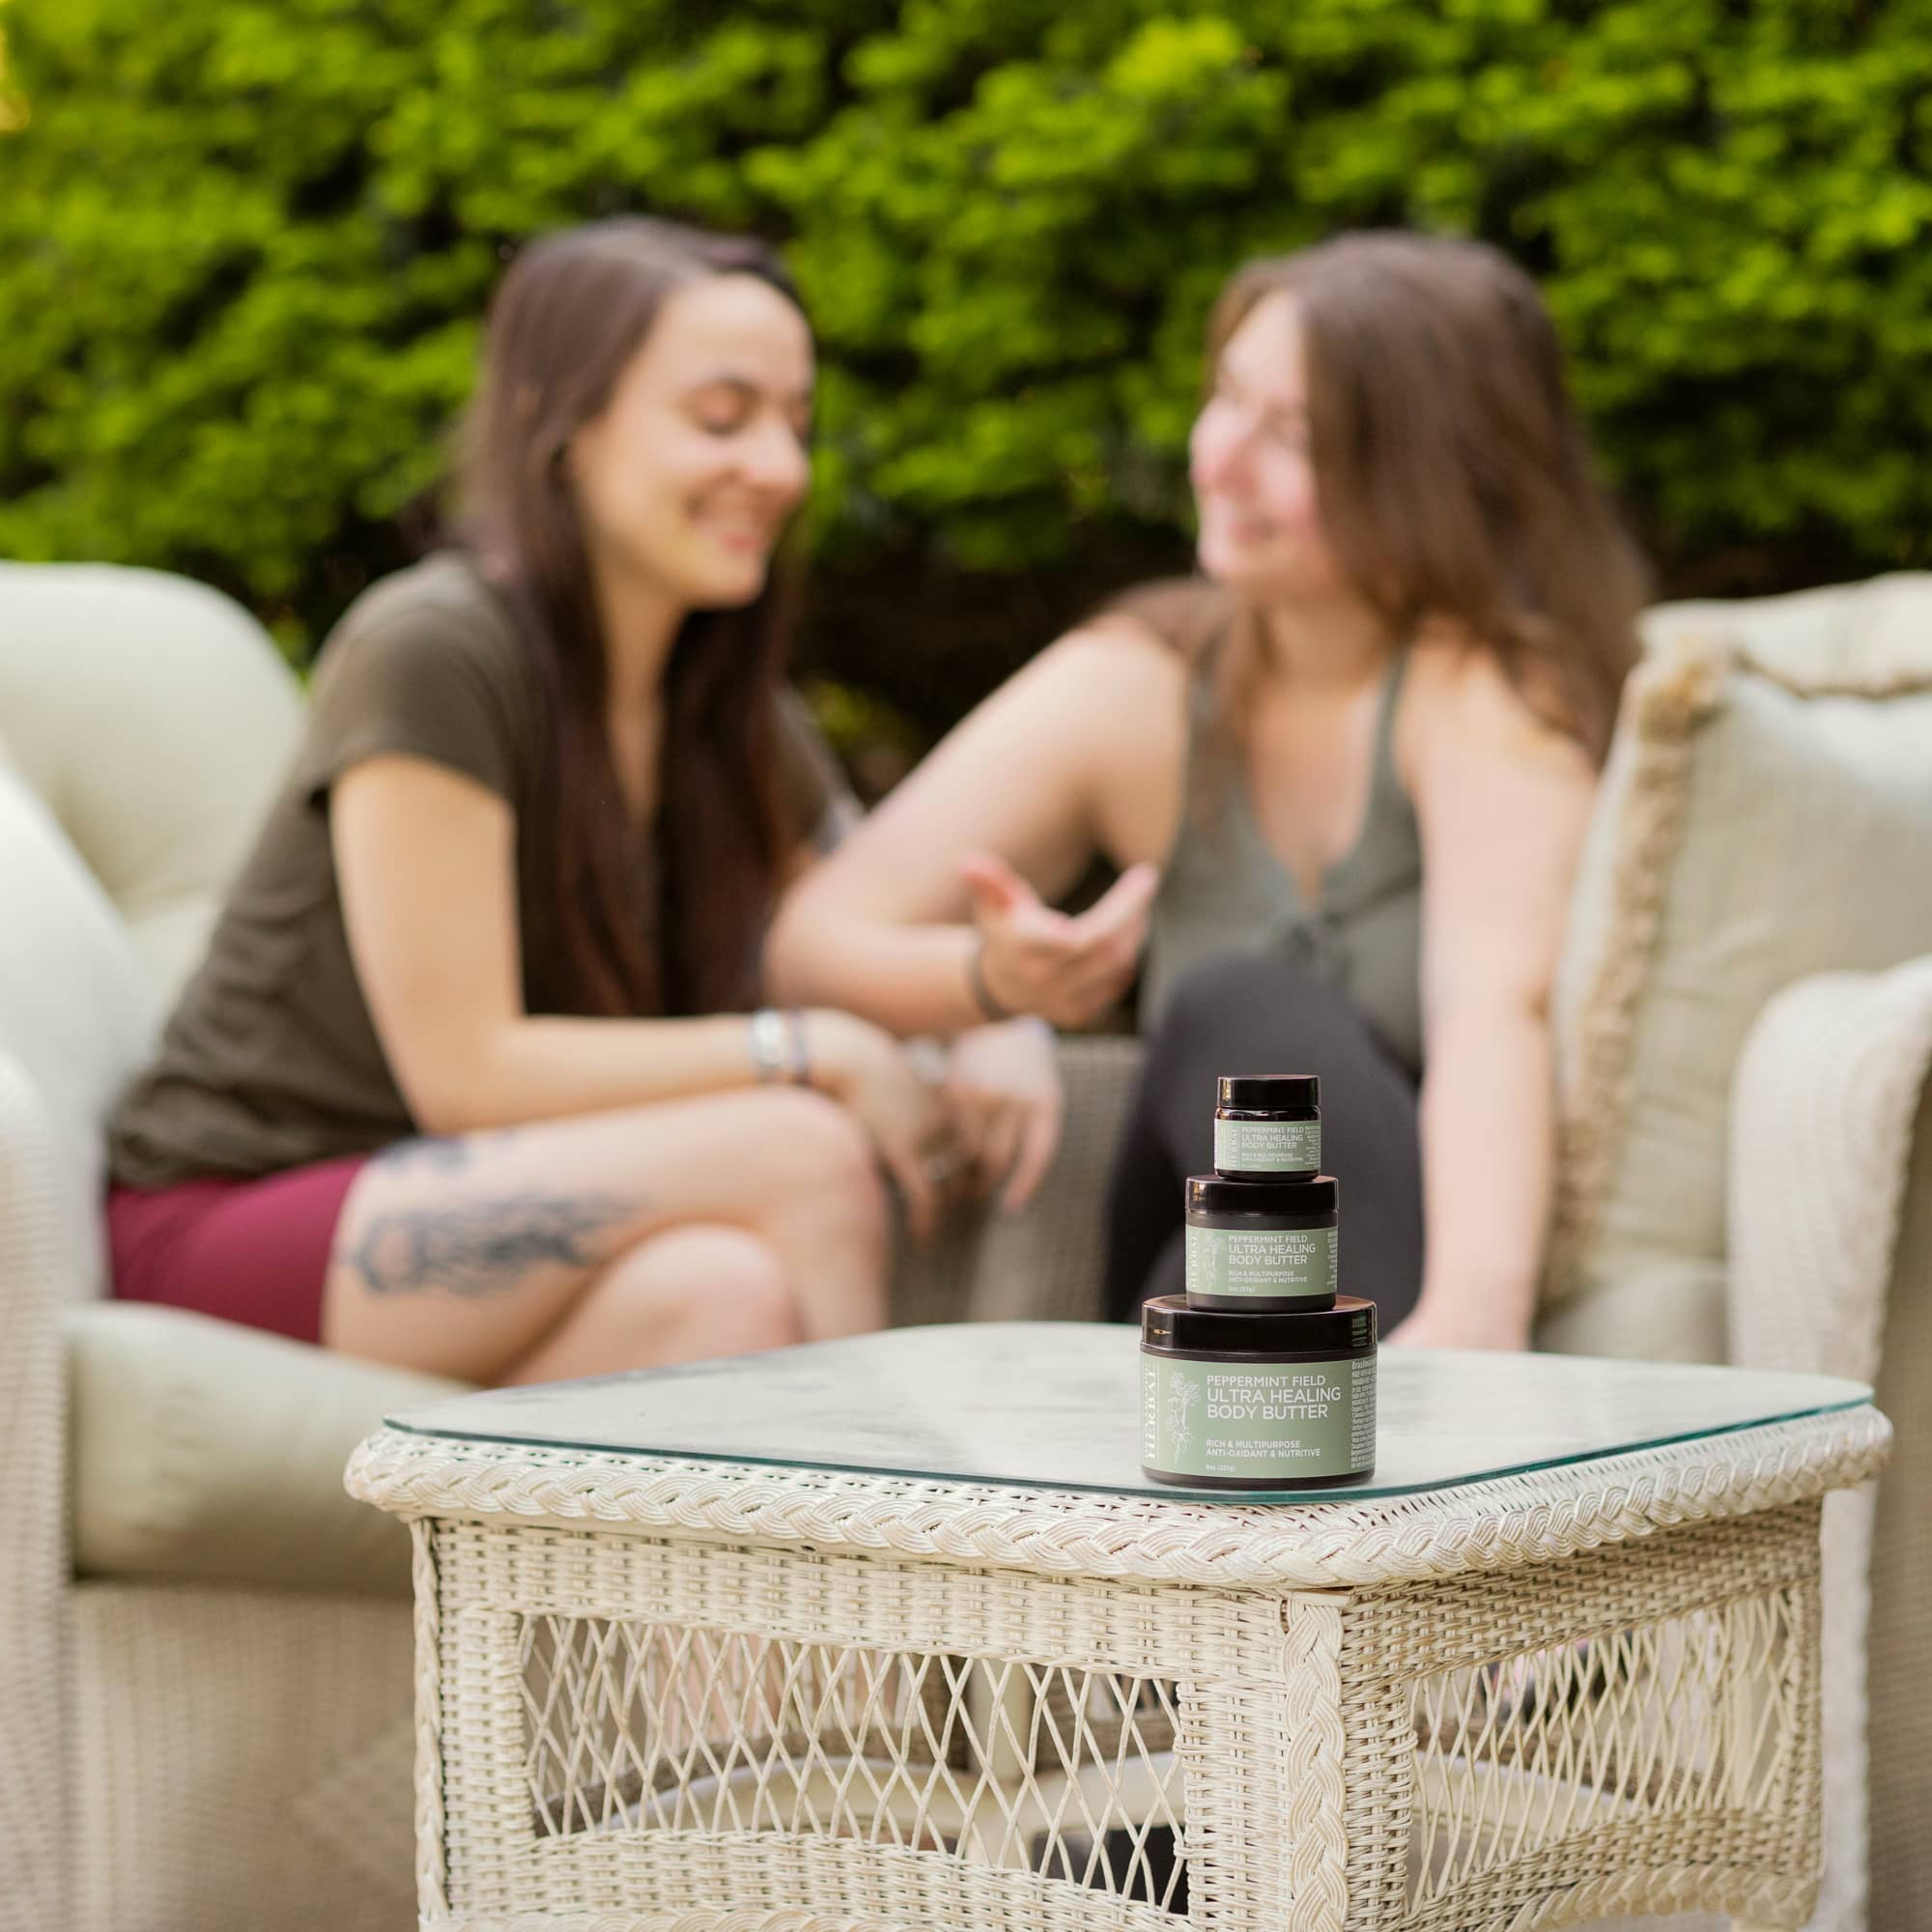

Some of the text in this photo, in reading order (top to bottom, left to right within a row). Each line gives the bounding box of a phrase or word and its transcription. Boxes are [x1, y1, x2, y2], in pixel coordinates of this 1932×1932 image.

[1229, 1235, 1308, 1243] PEPPERMINT FIELD
[1229, 1243, 1316, 1254] ULTRA HEALING
[1229, 1255, 1307, 1264] BODY BUTTER
[1207, 1375, 1326, 1387] PEPPERMINT FIELD
[1208, 1386, 1342, 1404] ULTRA HEALING
[1207, 1404, 1328, 1420] BODY BUTTER
[1207, 1438, 1301, 1449] RICH & MULTIPURPOSE
[1207, 1448, 1321, 1458] ANTI-OXIDANT & NUTRITIVE
